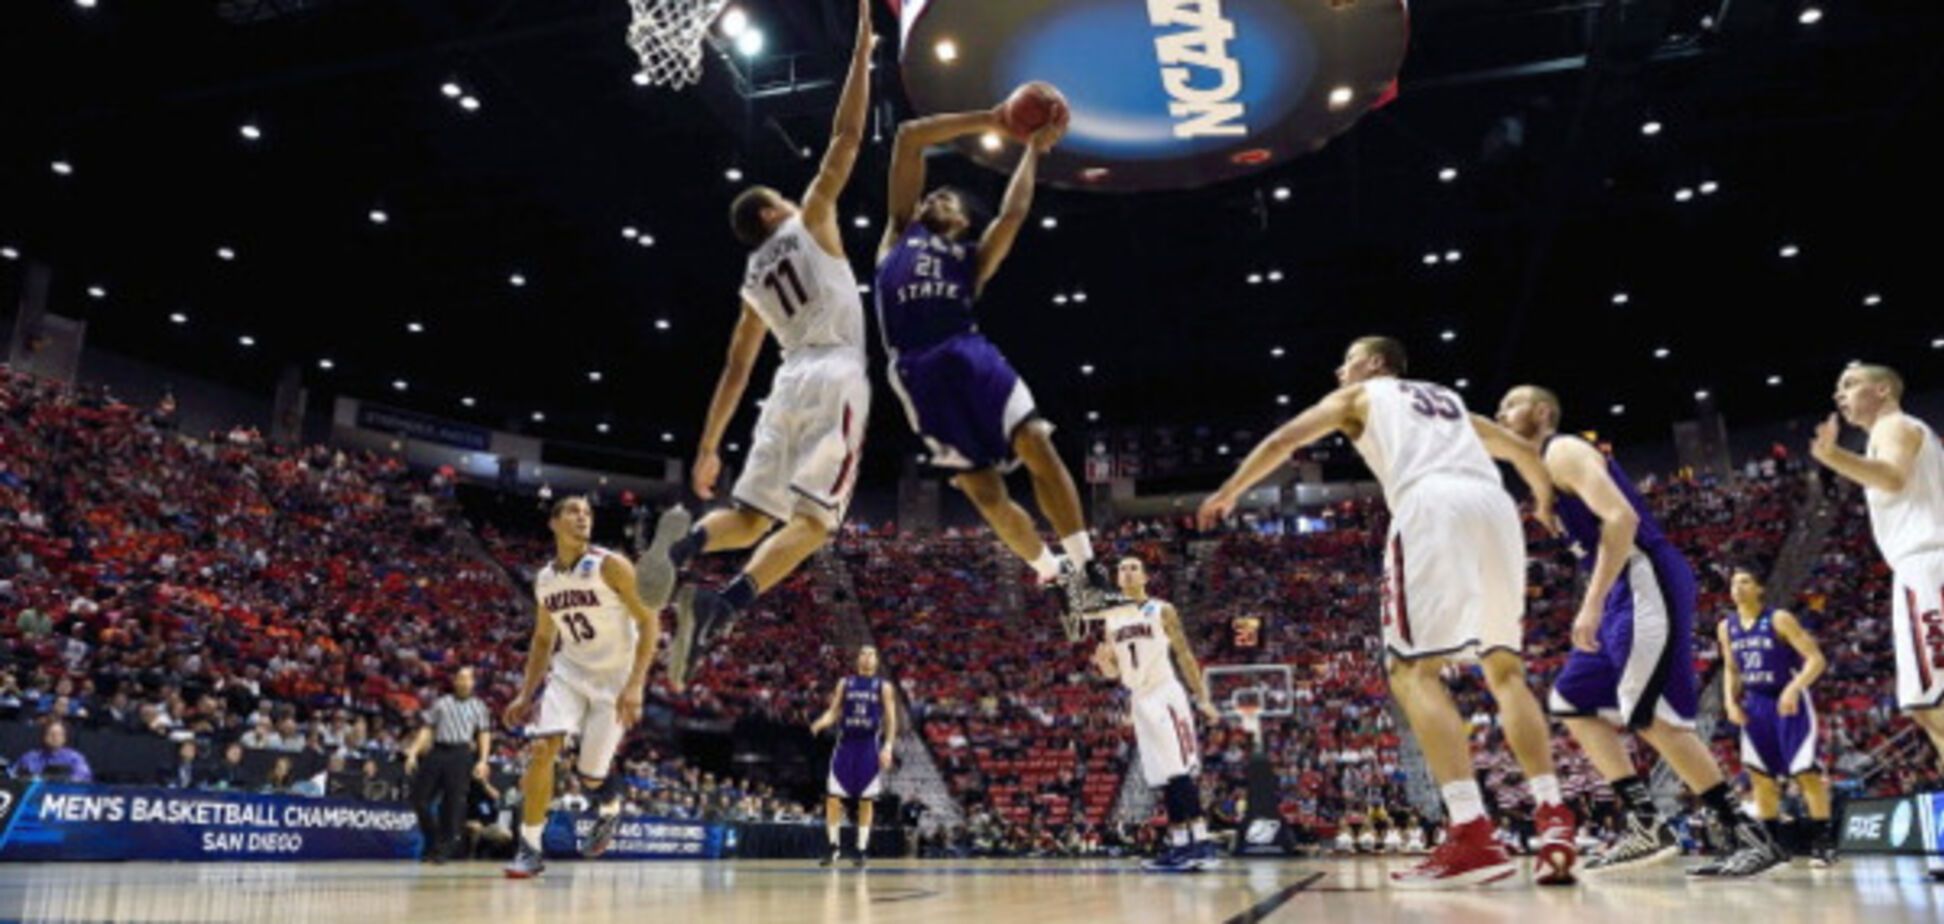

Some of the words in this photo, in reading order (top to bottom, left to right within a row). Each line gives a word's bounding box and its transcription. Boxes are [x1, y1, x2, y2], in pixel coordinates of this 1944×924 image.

[1146, 0, 1247, 138] NCAA
[915, 254, 942, 279] 21
[763, 257, 808, 318] 11
[897, 281, 958, 303] STATE
[1398, 383, 1462, 420] 35
[563, 611, 596, 643] 13
[1127, 642, 1139, 668] 1
[39, 794, 125, 821] MEN'S
[130, 797, 279, 827] BASKETBALL
[283, 806, 418, 831] CHAMPIONSHIP
[1845, 813, 1885, 840] AXE
[202, 832, 244, 851] SAN
[248, 833, 303, 851] DIEGO
